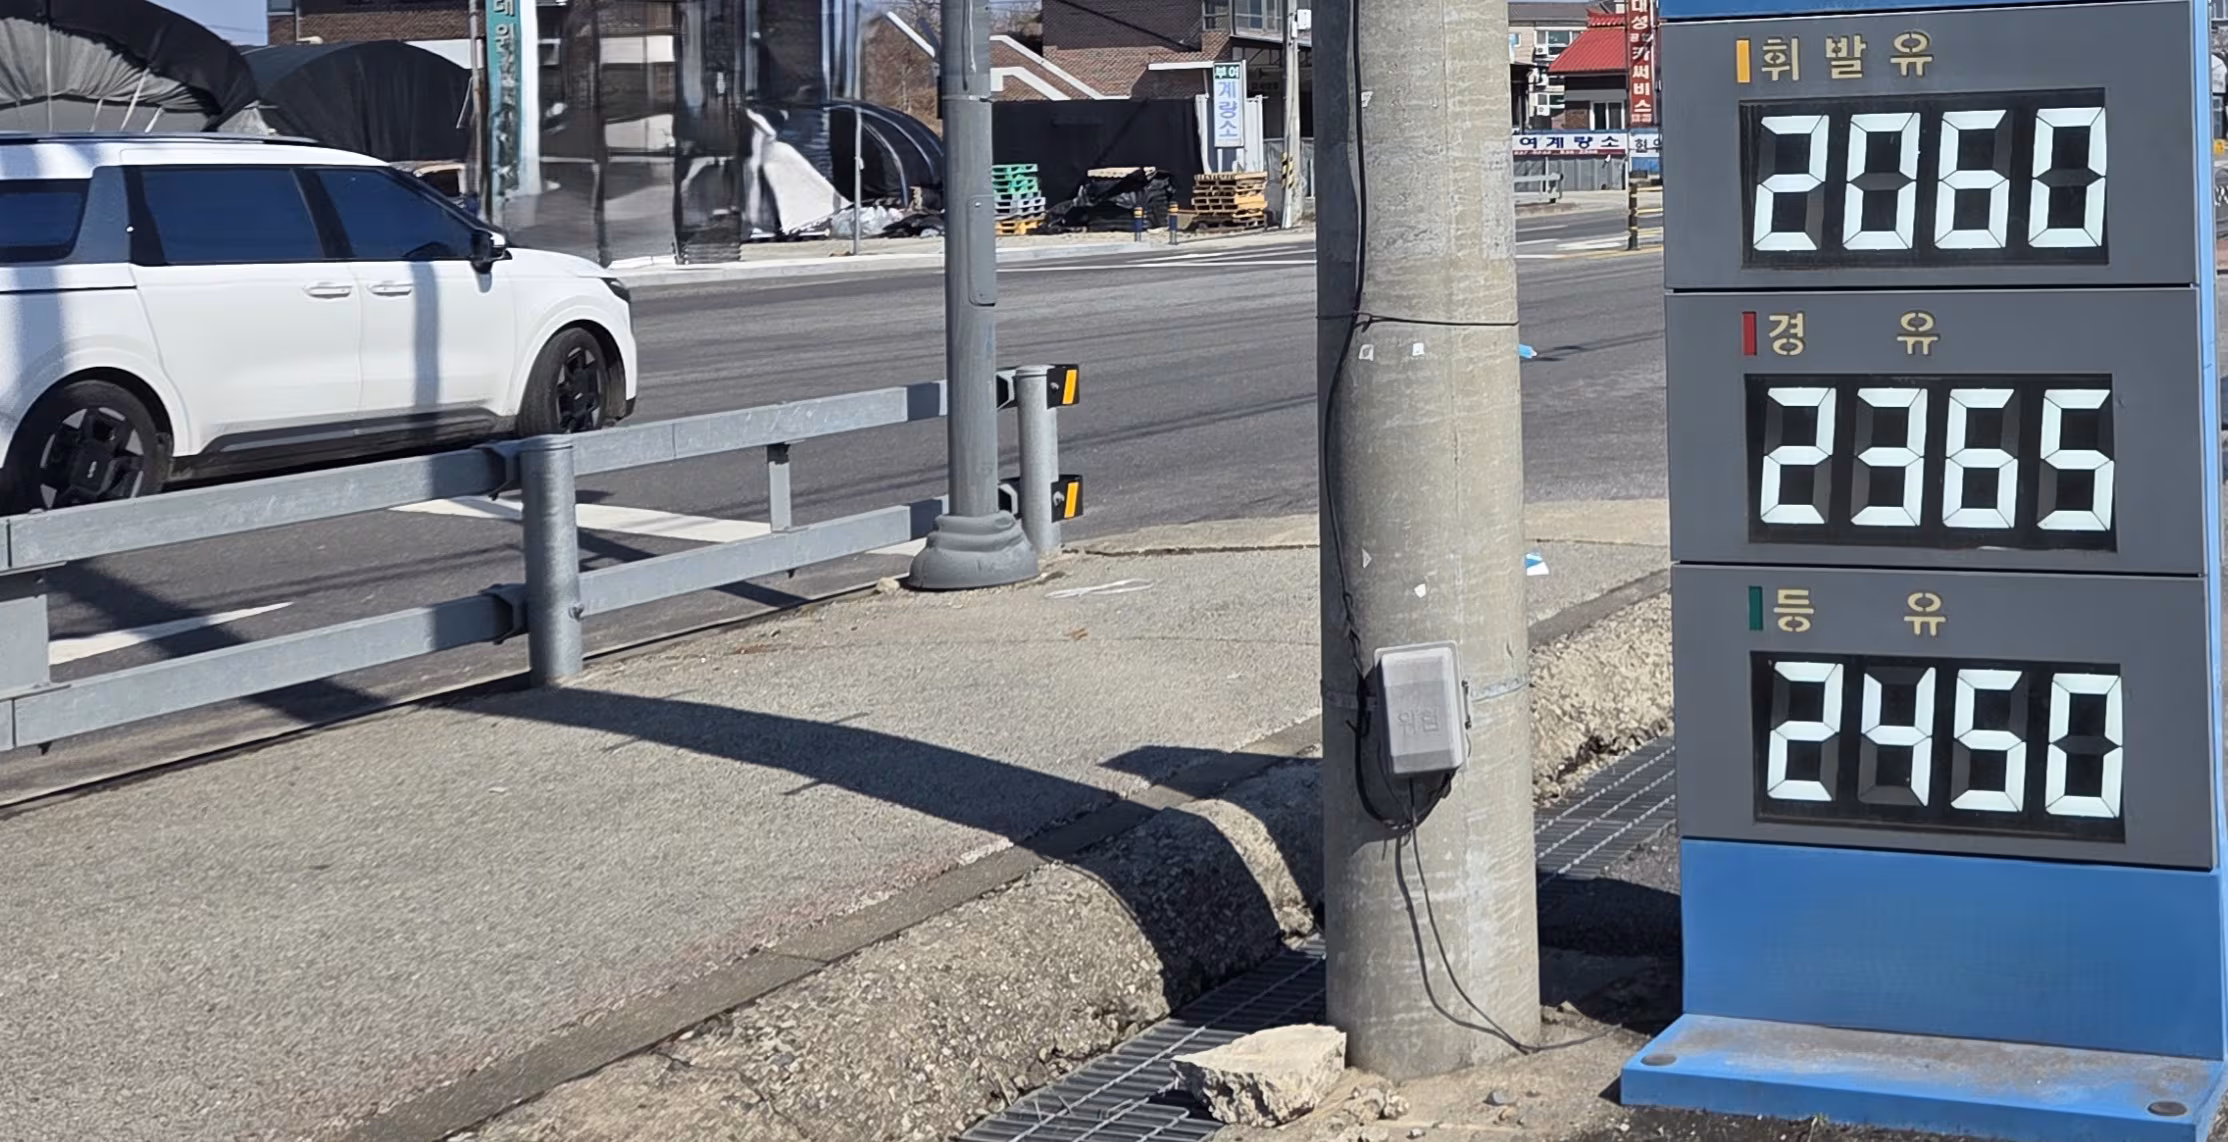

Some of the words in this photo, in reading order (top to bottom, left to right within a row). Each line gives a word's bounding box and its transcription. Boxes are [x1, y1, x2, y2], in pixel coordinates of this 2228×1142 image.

[1215, 66, 1240, 79] 부여
[1217, 81, 1238, 137] 계량소
[1753, 107, 2107, 251] 2060
[1760, 387, 2115, 531] 2365
[1767, 662, 2123, 818] 2450
